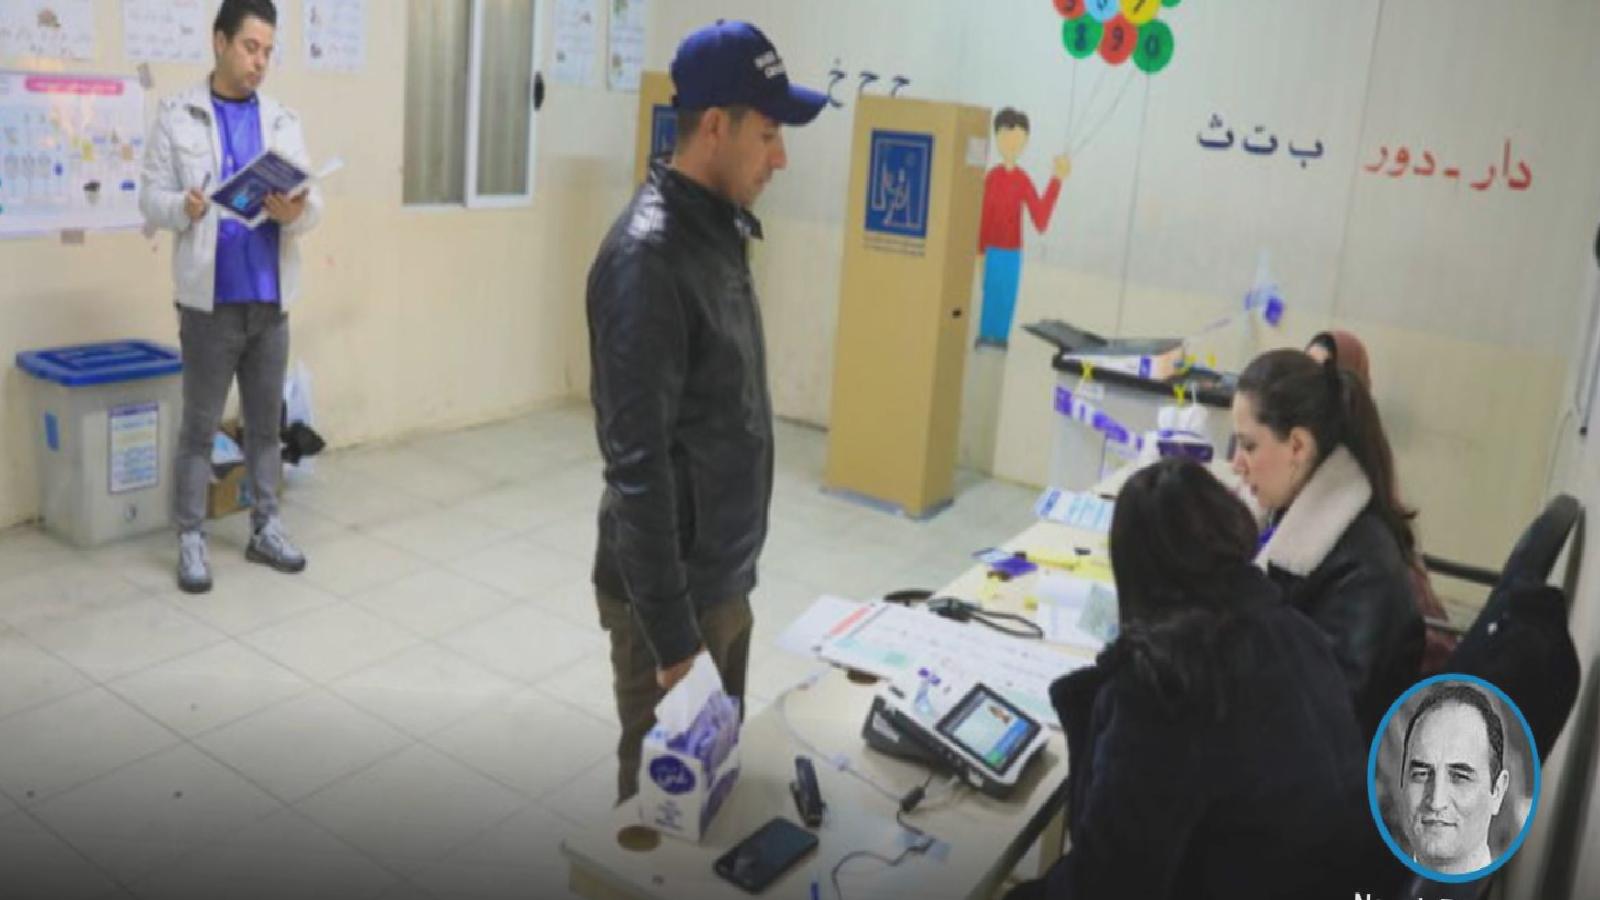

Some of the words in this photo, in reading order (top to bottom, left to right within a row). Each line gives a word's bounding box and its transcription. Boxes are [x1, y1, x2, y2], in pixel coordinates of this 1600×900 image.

[1074, 22, 1087, 51] 8
[1111, 25, 1125, 51] 9
[1143, 33, 1160, 59] 0
[1196, 113, 1234, 149] ث
[1242, 125, 1278, 154] ت
[1288, 139, 1324, 168] ب
[1363, 146, 1436, 178] دور
[1469, 138, 1532, 191] دار
